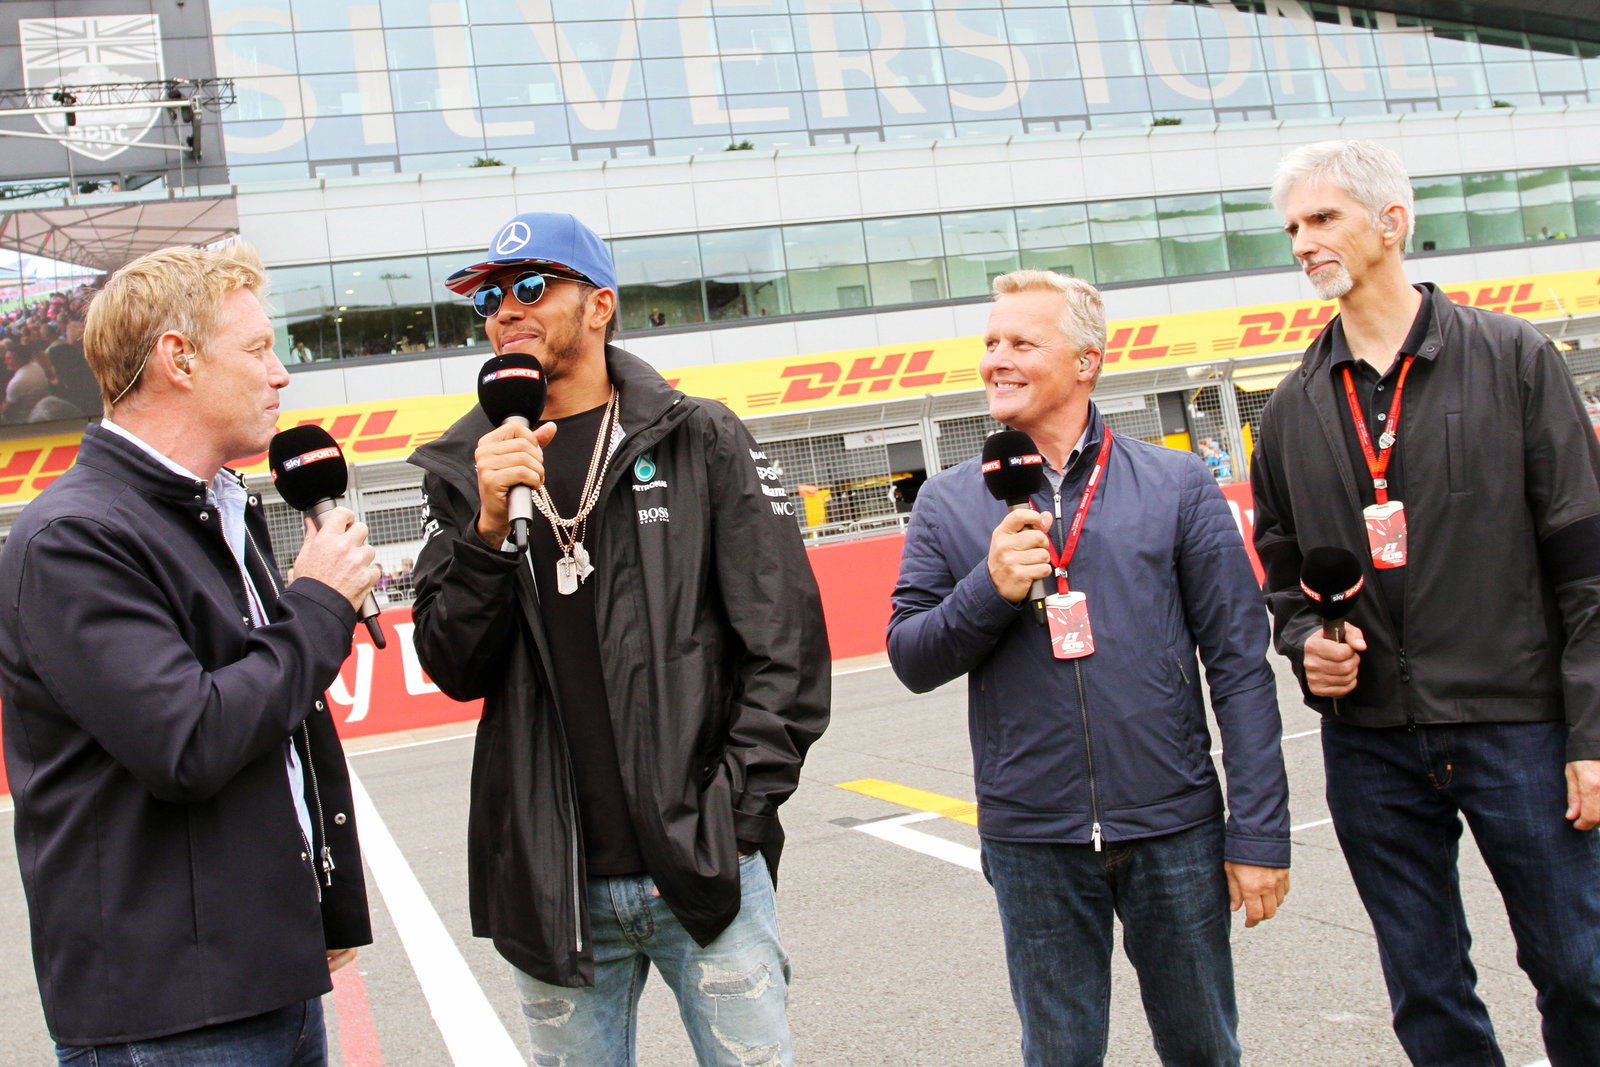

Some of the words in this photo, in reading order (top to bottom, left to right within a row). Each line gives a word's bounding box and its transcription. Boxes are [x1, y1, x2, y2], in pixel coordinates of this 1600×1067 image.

[212, 0, 1457, 154] SILVERSTONE
[1238, 306, 1337, 348] DH
[1104, 325, 1170, 364] HL
[499, 369, 539, 379] SPORTS
[780, 350, 947, 404] DHL
[0, 445, 80, 495] HL
[285, 458, 301, 470] sky
[303, 447, 339, 463] SPORTS
[1010, 456, 1022, 466] sky
[632, 480, 668, 492] PETRONAS
[638, 506, 670, 521] BOSS
[770, 501, 795, 516] IWC
